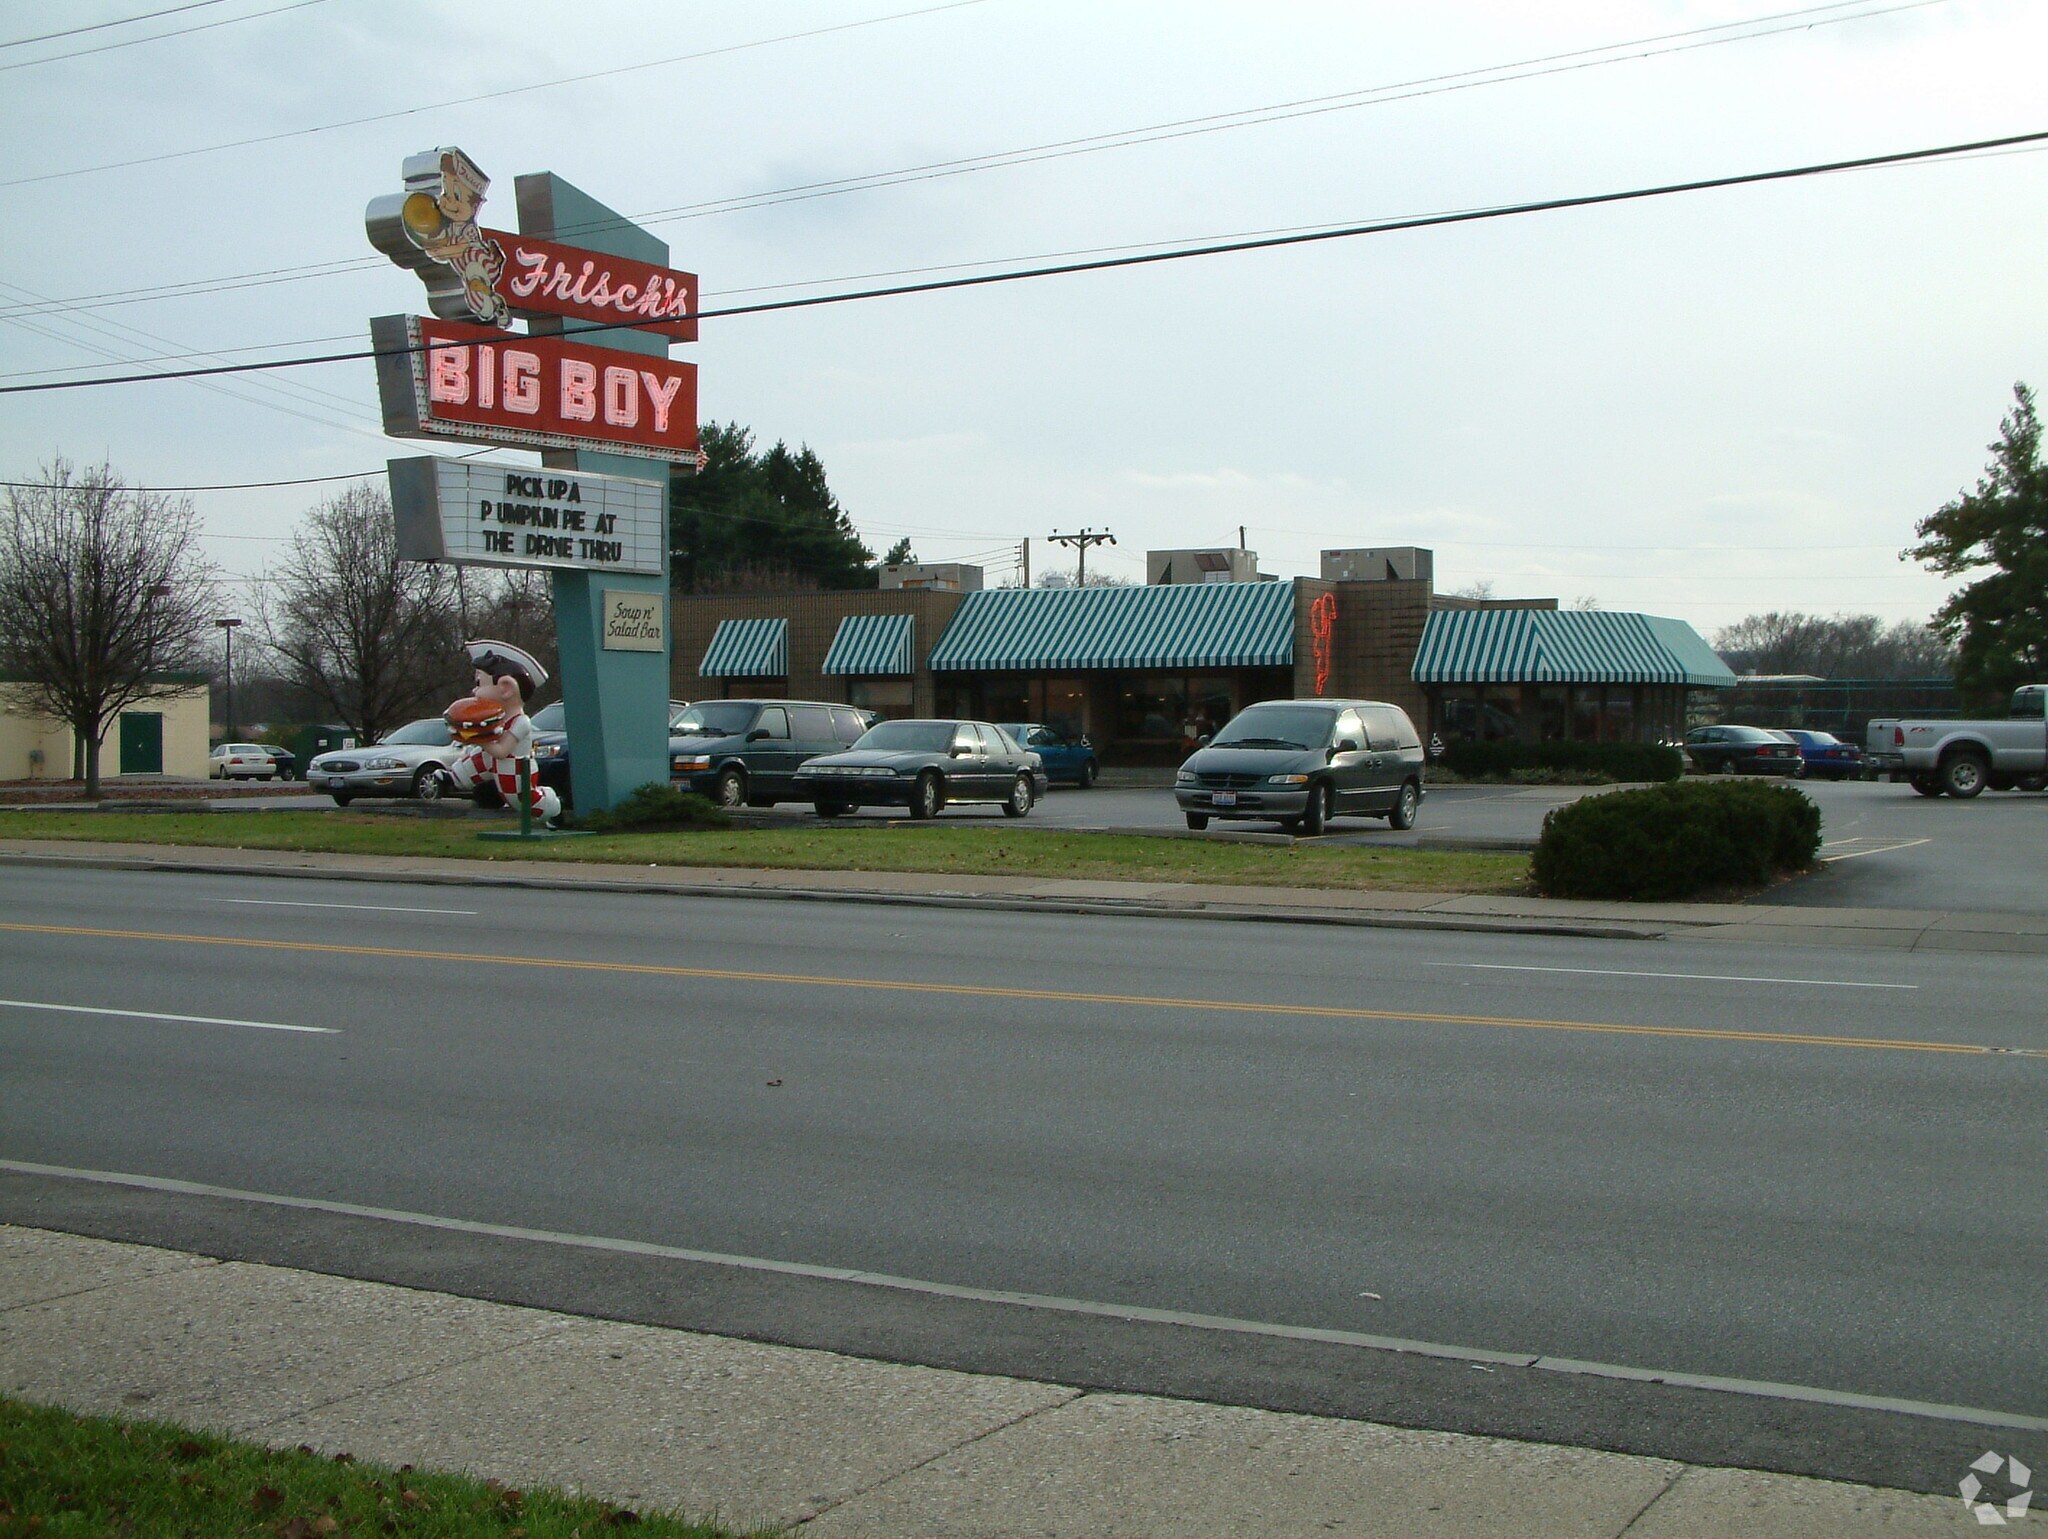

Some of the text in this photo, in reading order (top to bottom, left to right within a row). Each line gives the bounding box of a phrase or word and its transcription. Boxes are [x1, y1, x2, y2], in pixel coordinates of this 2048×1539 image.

[510, 247, 688, 322] Frisch's
[430, 336, 682, 432] BIG BOY
[507, 474, 581, 503] PICK UP A
[595, 513, 617, 534] AT
[483, 530, 622, 561] THE DRIVE THRU
[614, 602, 642, 623] Soup
[607, 620, 661, 639] Salad Bar
